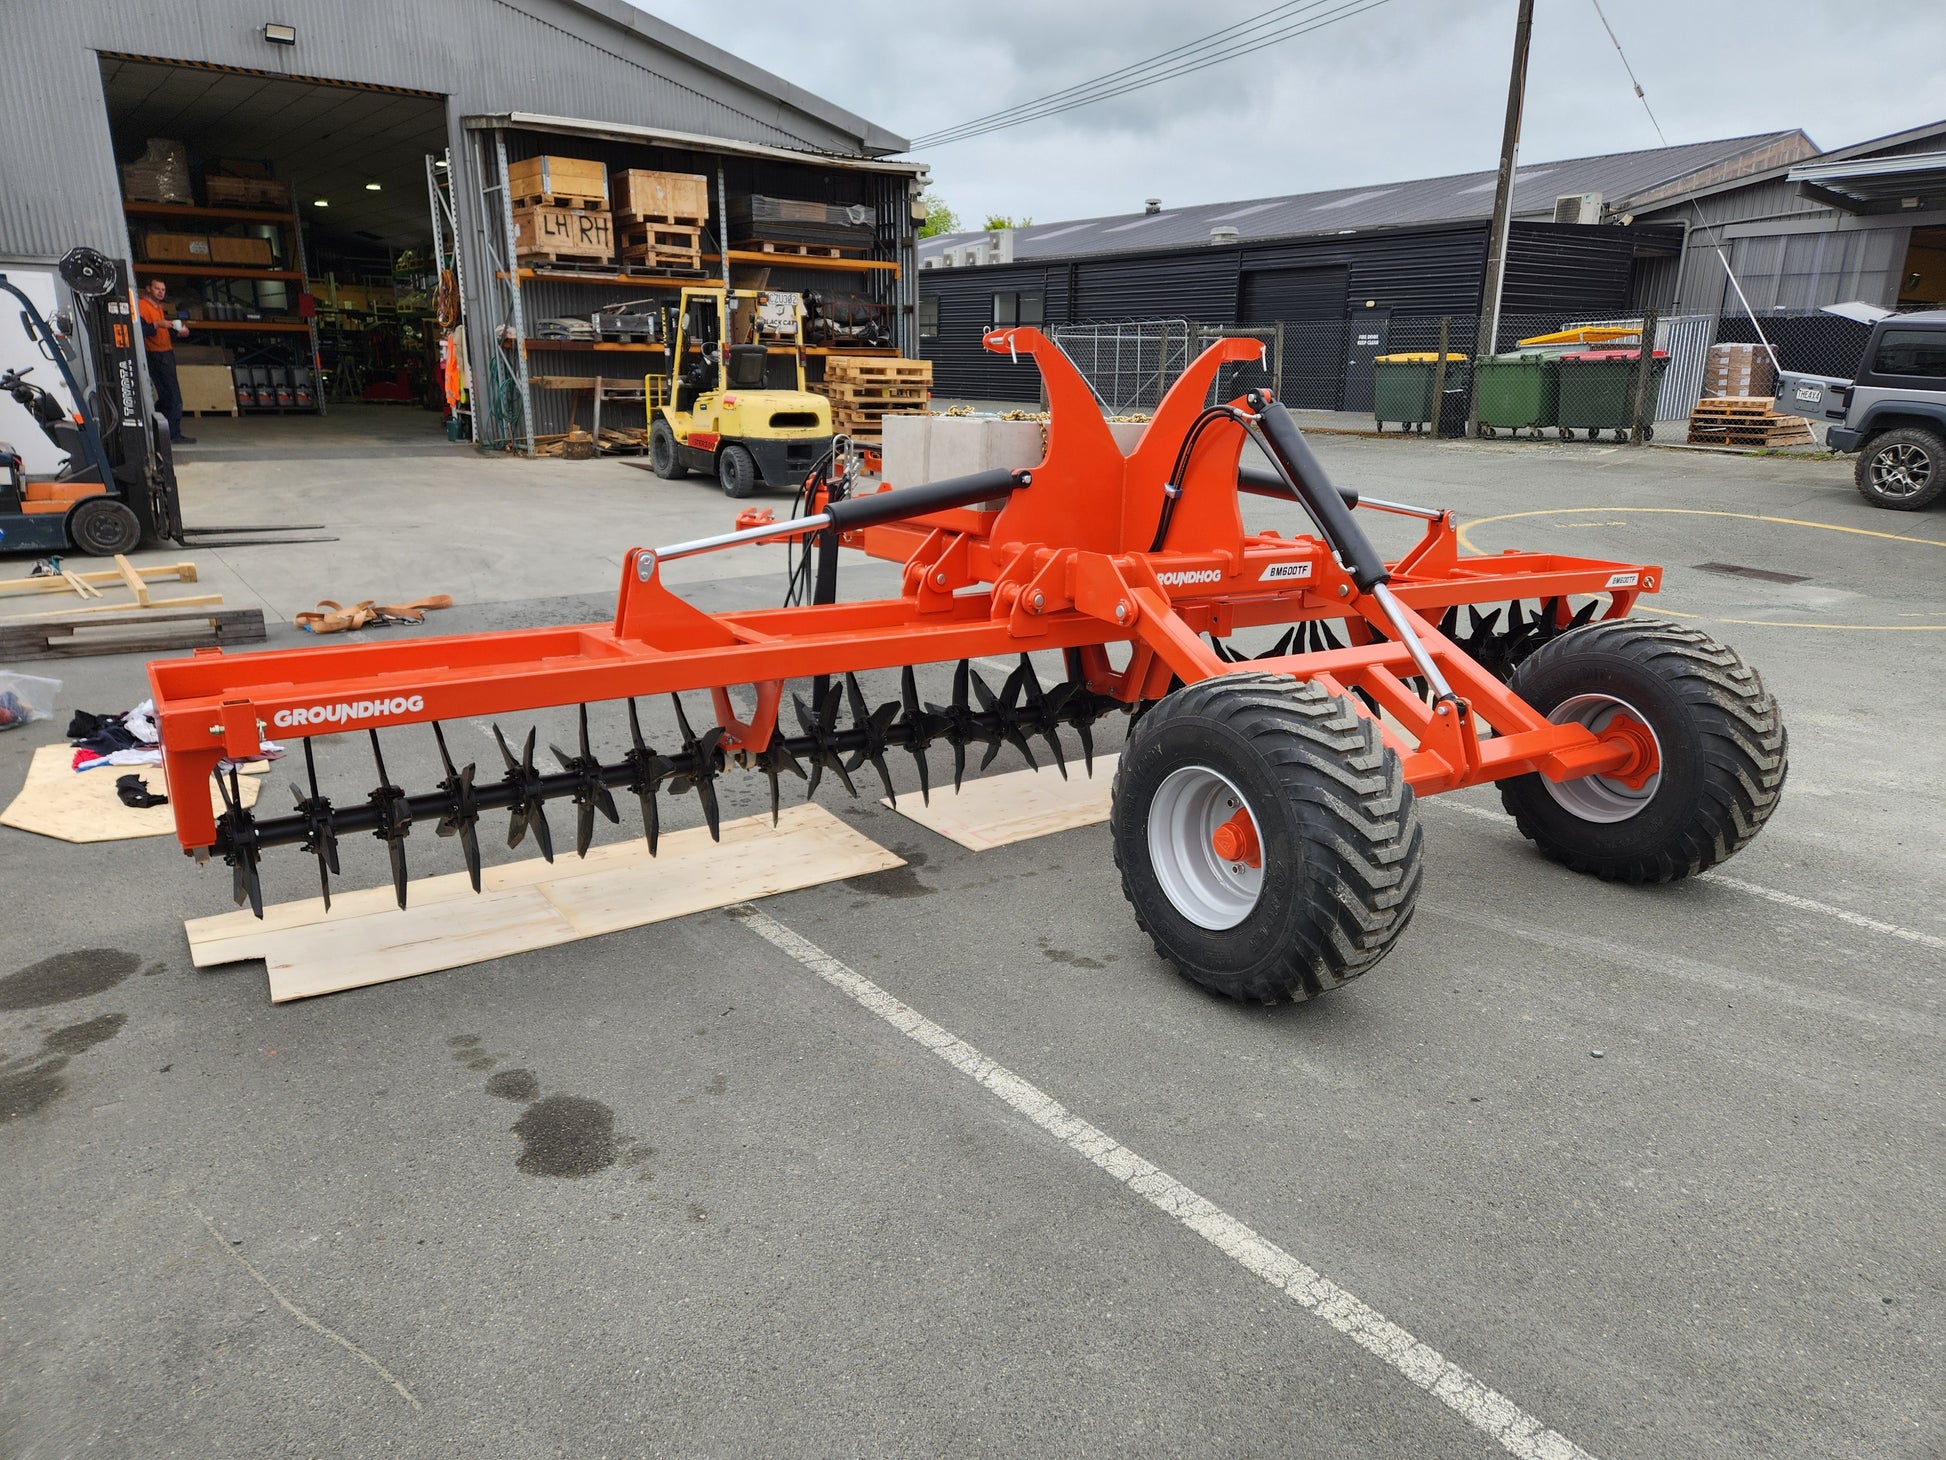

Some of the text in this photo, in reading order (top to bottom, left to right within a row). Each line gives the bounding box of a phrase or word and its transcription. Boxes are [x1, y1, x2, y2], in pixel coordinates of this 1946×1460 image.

[543, 214, 609, 250] LH RH
[119, 359, 135, 417] TOYOTA
[1156, 569, 1222, 588] ROUNDHOG
[1270, 565, 1308, 577] BM600TF
[273, 694, 424, 728] GROUNDHOG
